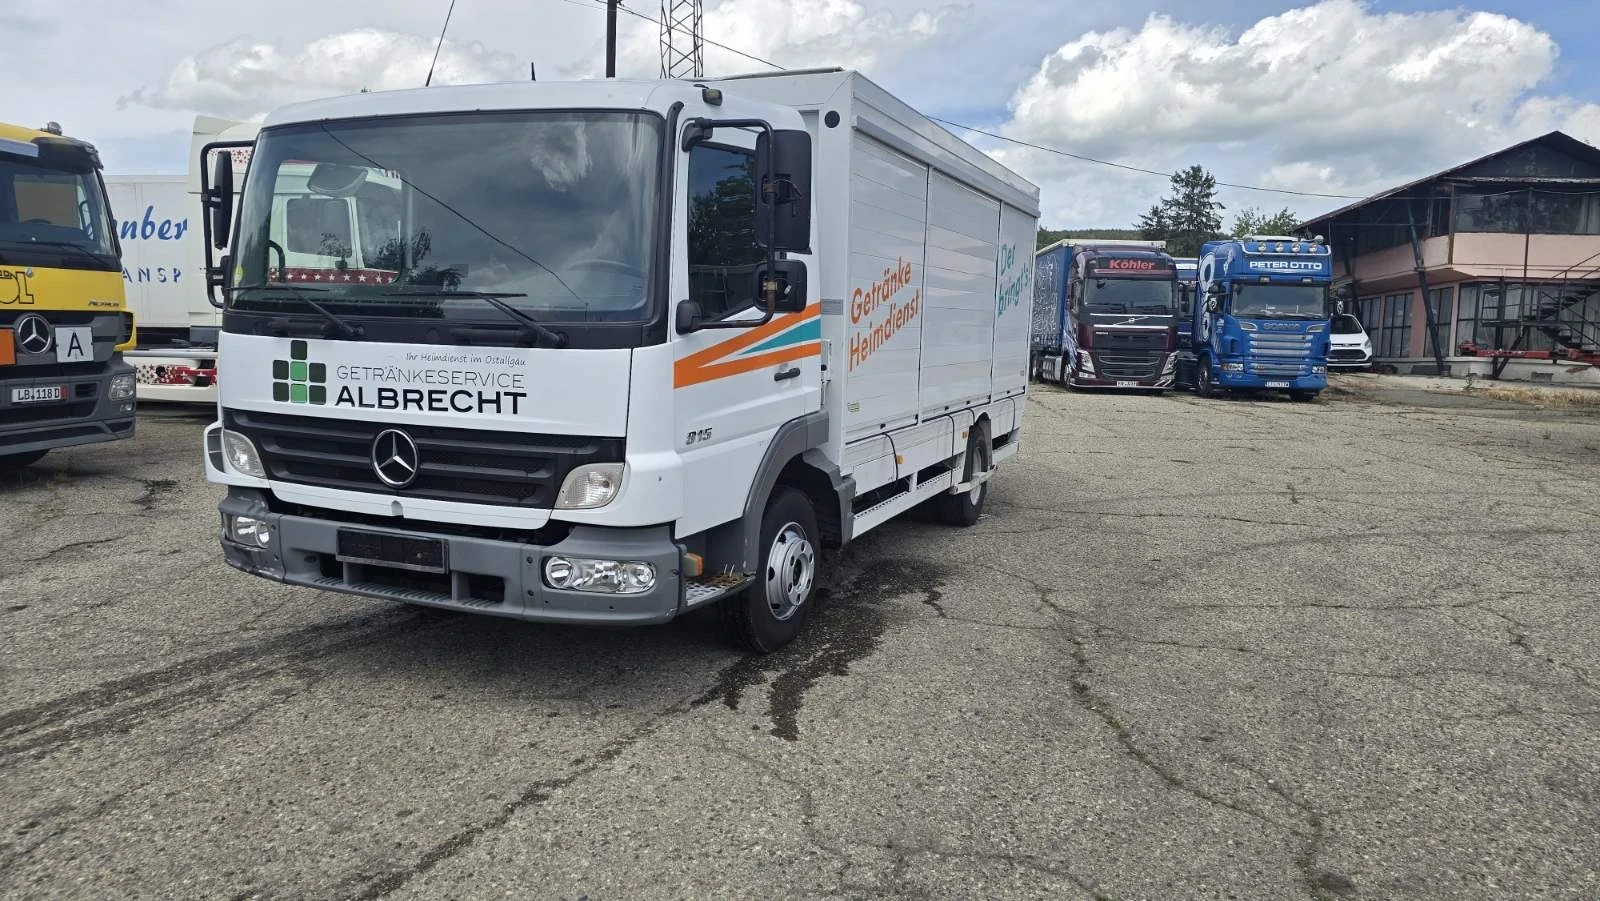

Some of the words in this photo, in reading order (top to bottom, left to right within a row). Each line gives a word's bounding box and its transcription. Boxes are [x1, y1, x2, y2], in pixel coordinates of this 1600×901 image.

[116, 205, 188, 240] nber
[1109, 259, 1155, 270] Köhler
[1249, 261, 1288, 270] PETER
[1290, 262, 1322, 270] OTTO
[850, 256, 911, 325] Getränke
[849, 287, 920, 372] Heimdienst
[67, 331, 84, 357] A
[406, 352, 418, 361] Ihr
[421, 353, 467, 364] Heimdienst
[470, 354, 482, 363] im
[336, 365, 525, 389] GETRÄNKESERVICE
[335, 385, 527, 415] ALBRECHT
